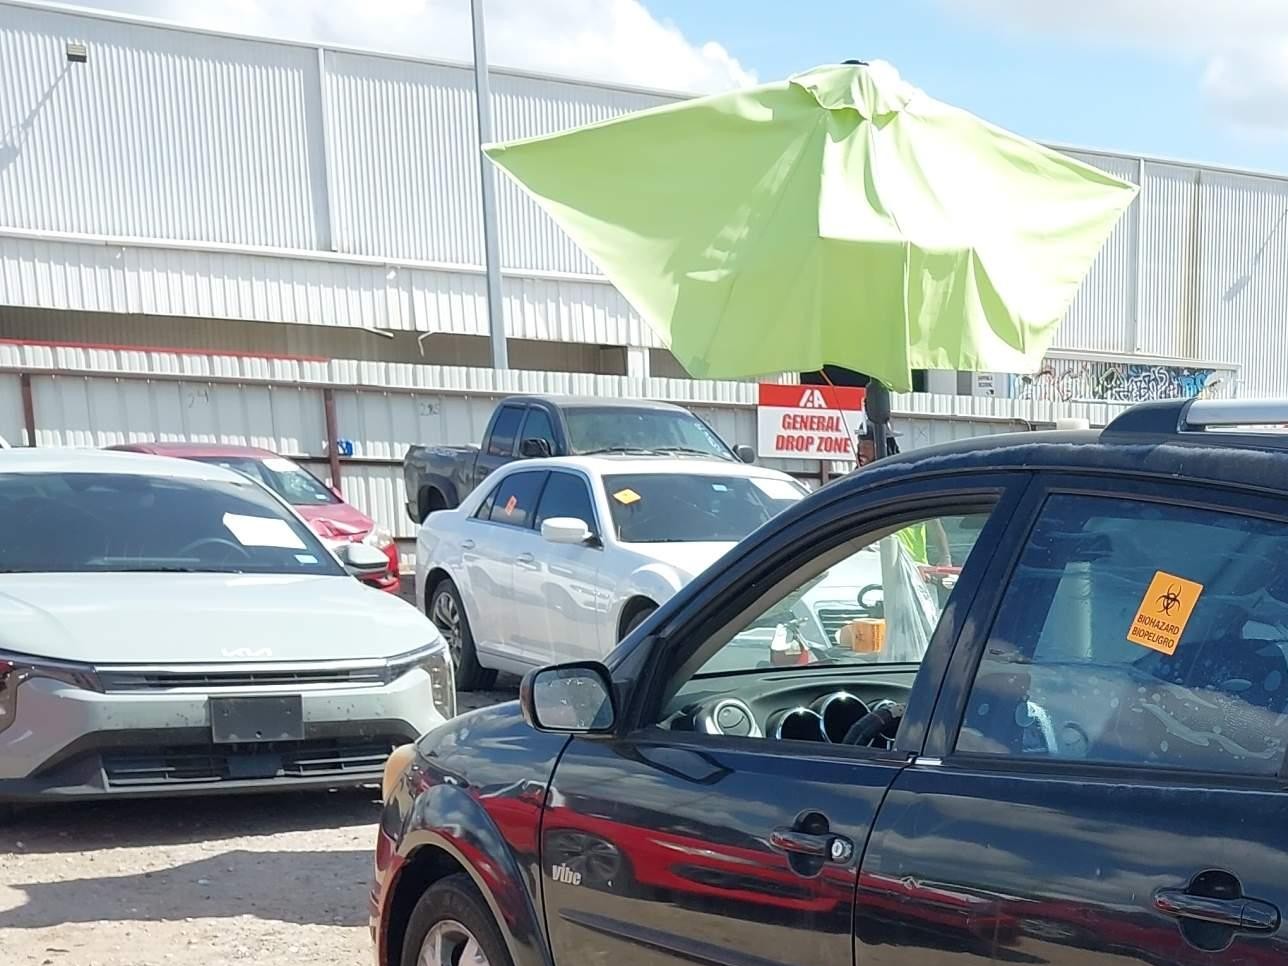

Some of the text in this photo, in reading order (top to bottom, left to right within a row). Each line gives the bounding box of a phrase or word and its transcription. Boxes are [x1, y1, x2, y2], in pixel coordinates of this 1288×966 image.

[782, 413, 842, 433] GENERAL
[776, 434, 852, 454] DROP ZONE
[1137, 614, 1180, 636] BIOHAZARD
[1132, 626, 1176, 649] BIOPELIGRO
